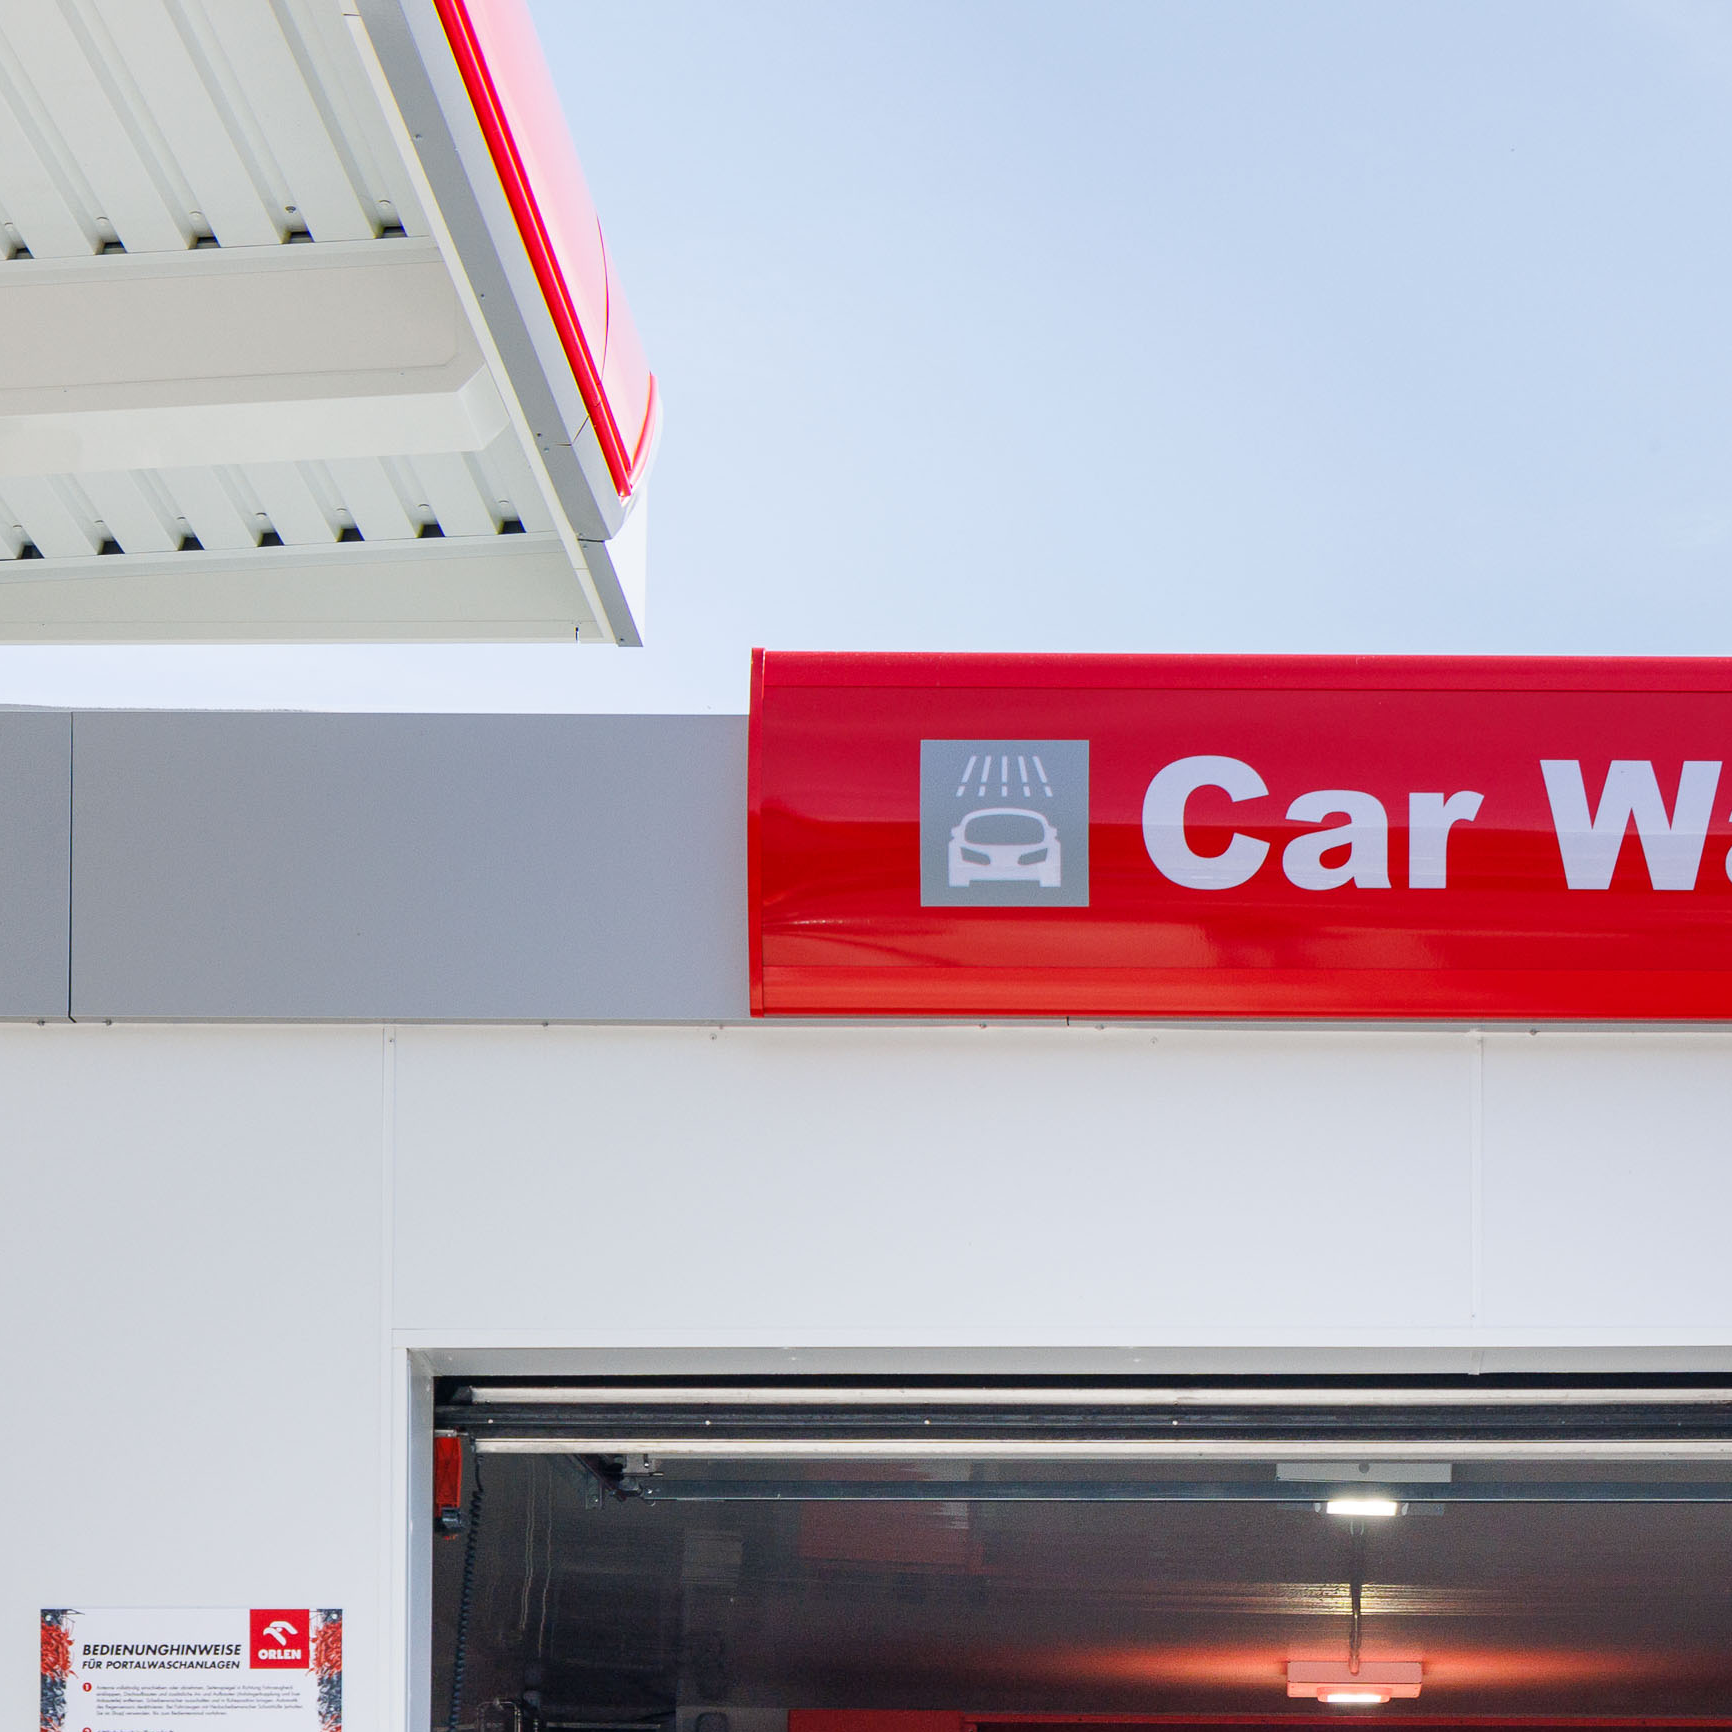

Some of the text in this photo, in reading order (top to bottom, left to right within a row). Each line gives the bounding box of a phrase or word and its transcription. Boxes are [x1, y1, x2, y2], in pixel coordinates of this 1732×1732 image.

[1140, 755, 1483, 891] Car
[82, 1644, 242, 1656] BEDIENUNGHINWEISE
[257, 1649, 302, 1660] ORLEN
[82, 1658, 241, 1670] FÜR PORTALWASCHANLAGEN
